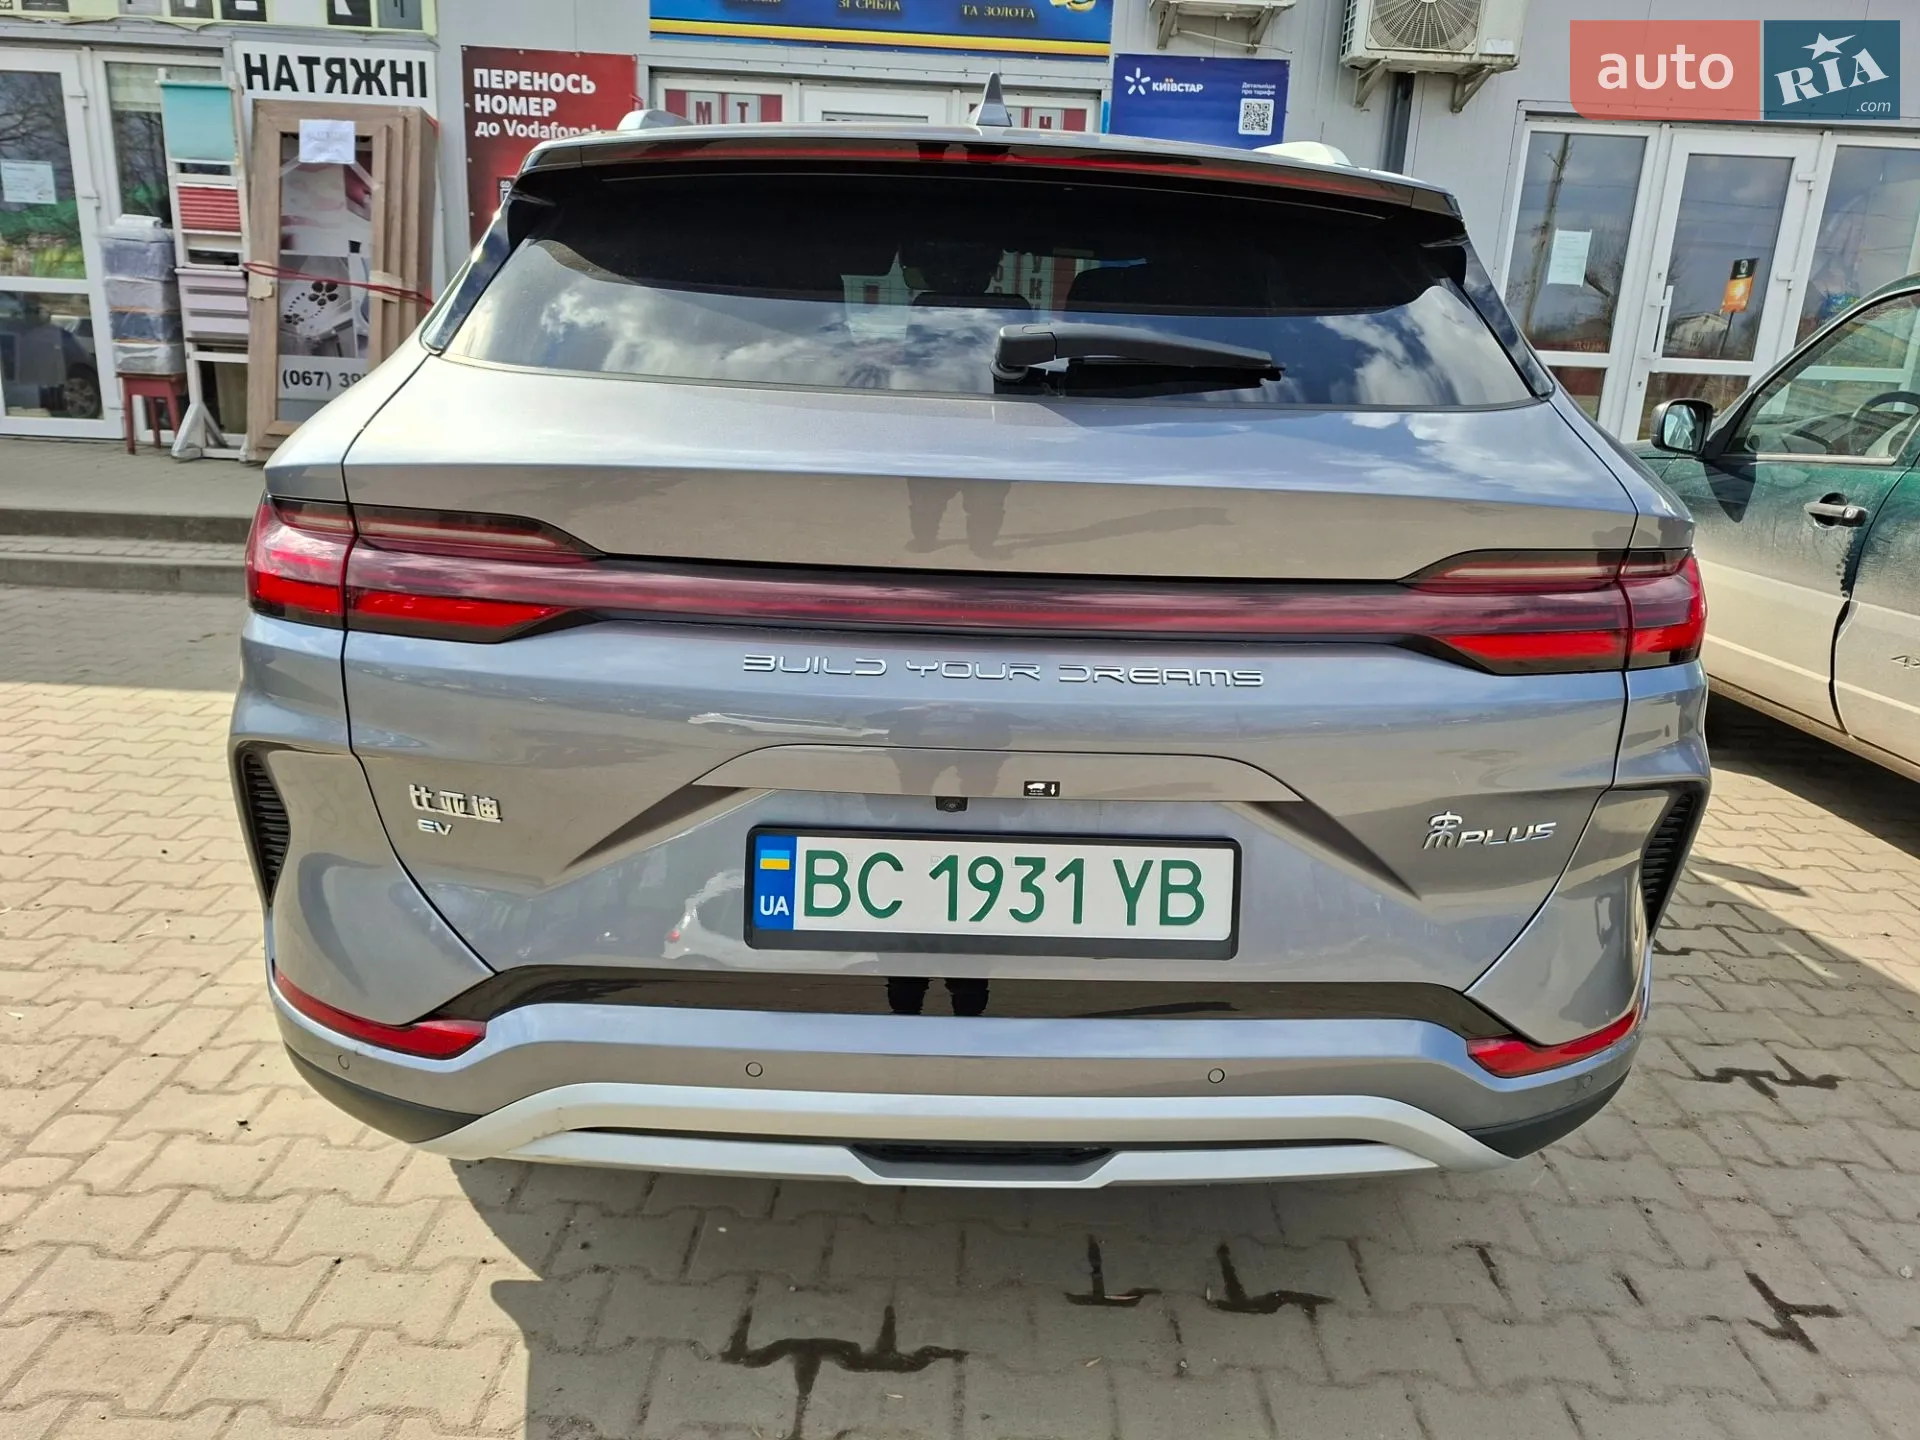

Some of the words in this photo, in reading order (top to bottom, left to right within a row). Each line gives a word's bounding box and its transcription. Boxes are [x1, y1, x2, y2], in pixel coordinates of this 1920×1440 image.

[855, 0, 900, 10] СРІБЛА
[962, 5, 978, 16] ТА
[984, 6, 1035, 19] ЗОЛОТА
[243, 53, 428, 98] НАТЯЖНІ
[473, 68, 597, 94] ПЕРЕНОСЬ
[1152, 79, 1204, 93] КИЇВСТАР
[474, 94, 557, 117] НОМЕР
[475, 121, 500, 137] до
[282, 369, 332, 392] (067)
[338, 373, 366, 388] 39
[743, 654, 887, 676] BUILD
[906, 660, 1040, 681] YOUR
[1059, 664, 1265, 687] DREAMS
[409, 784, 501, 823] 比亚迪
[417, 819, 452, 836] EV
[1456, 822, 1557, 848] PLUS
[760, 894, 790, 917] UA
[804, 849, 904, 919] BC
[928, 854, 1084, 925] 1931
[1112, 858, 1205, 927] YB
